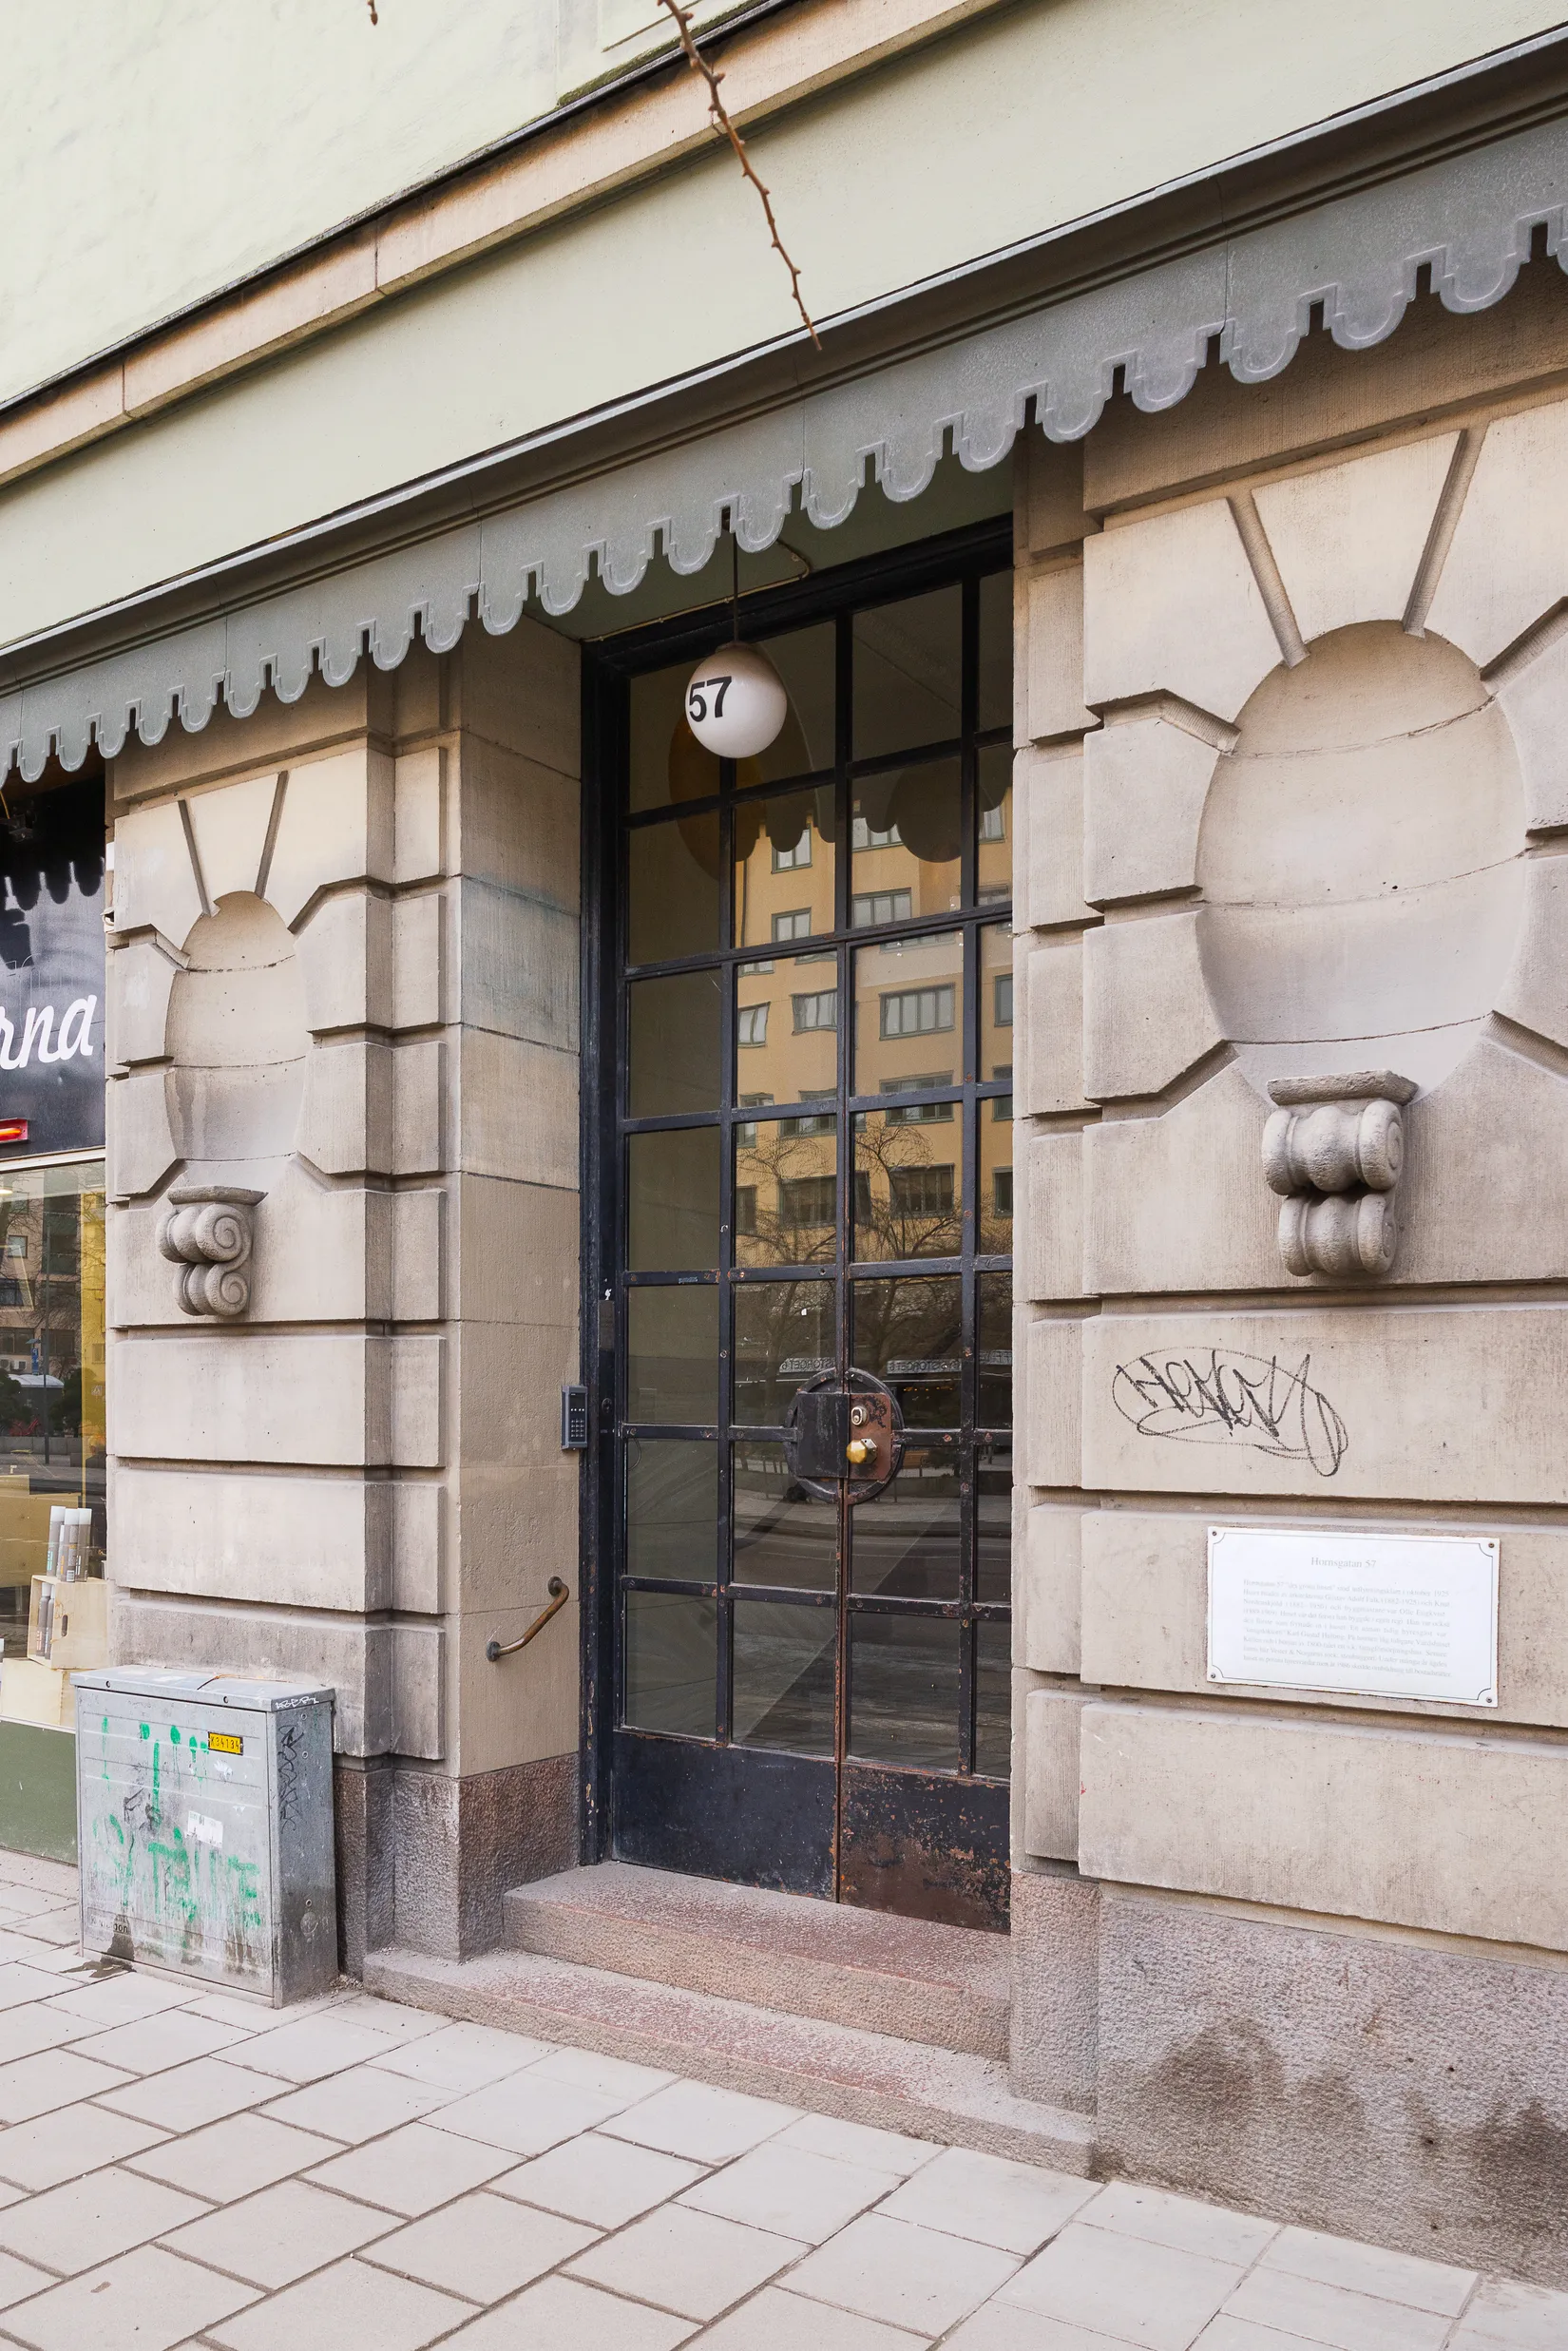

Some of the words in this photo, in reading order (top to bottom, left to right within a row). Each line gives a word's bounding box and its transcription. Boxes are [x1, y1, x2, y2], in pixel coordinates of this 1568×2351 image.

[689, 676, 733, 722] 57
[1310, 1557, 1362, 1569] Hornsgatan
[1365, 1559, 1377, 1569] 57
